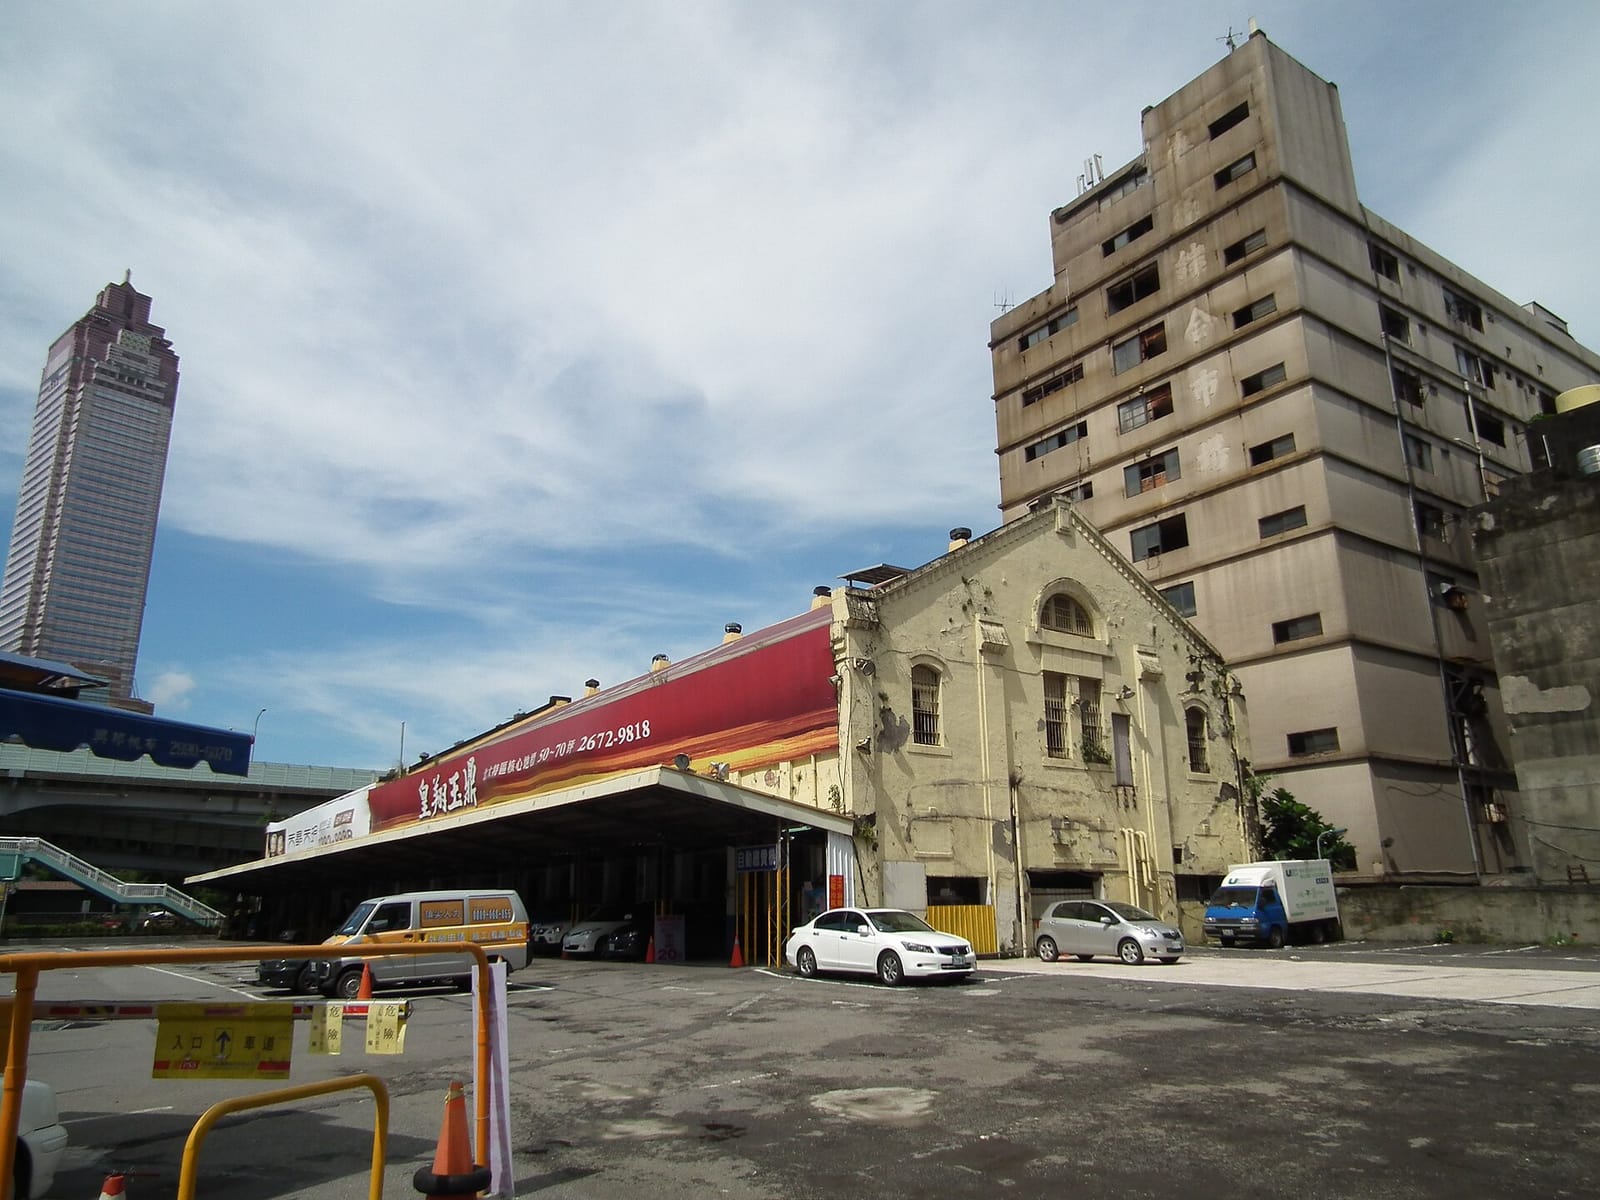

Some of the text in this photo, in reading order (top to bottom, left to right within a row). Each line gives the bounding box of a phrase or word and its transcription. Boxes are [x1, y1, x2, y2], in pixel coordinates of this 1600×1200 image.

[577, 719, 651, 752] 2672-9818
[418, 756, 478, 819] 皇翔玉鼎
[171, 1034, 275, 1051] 入口 車道
